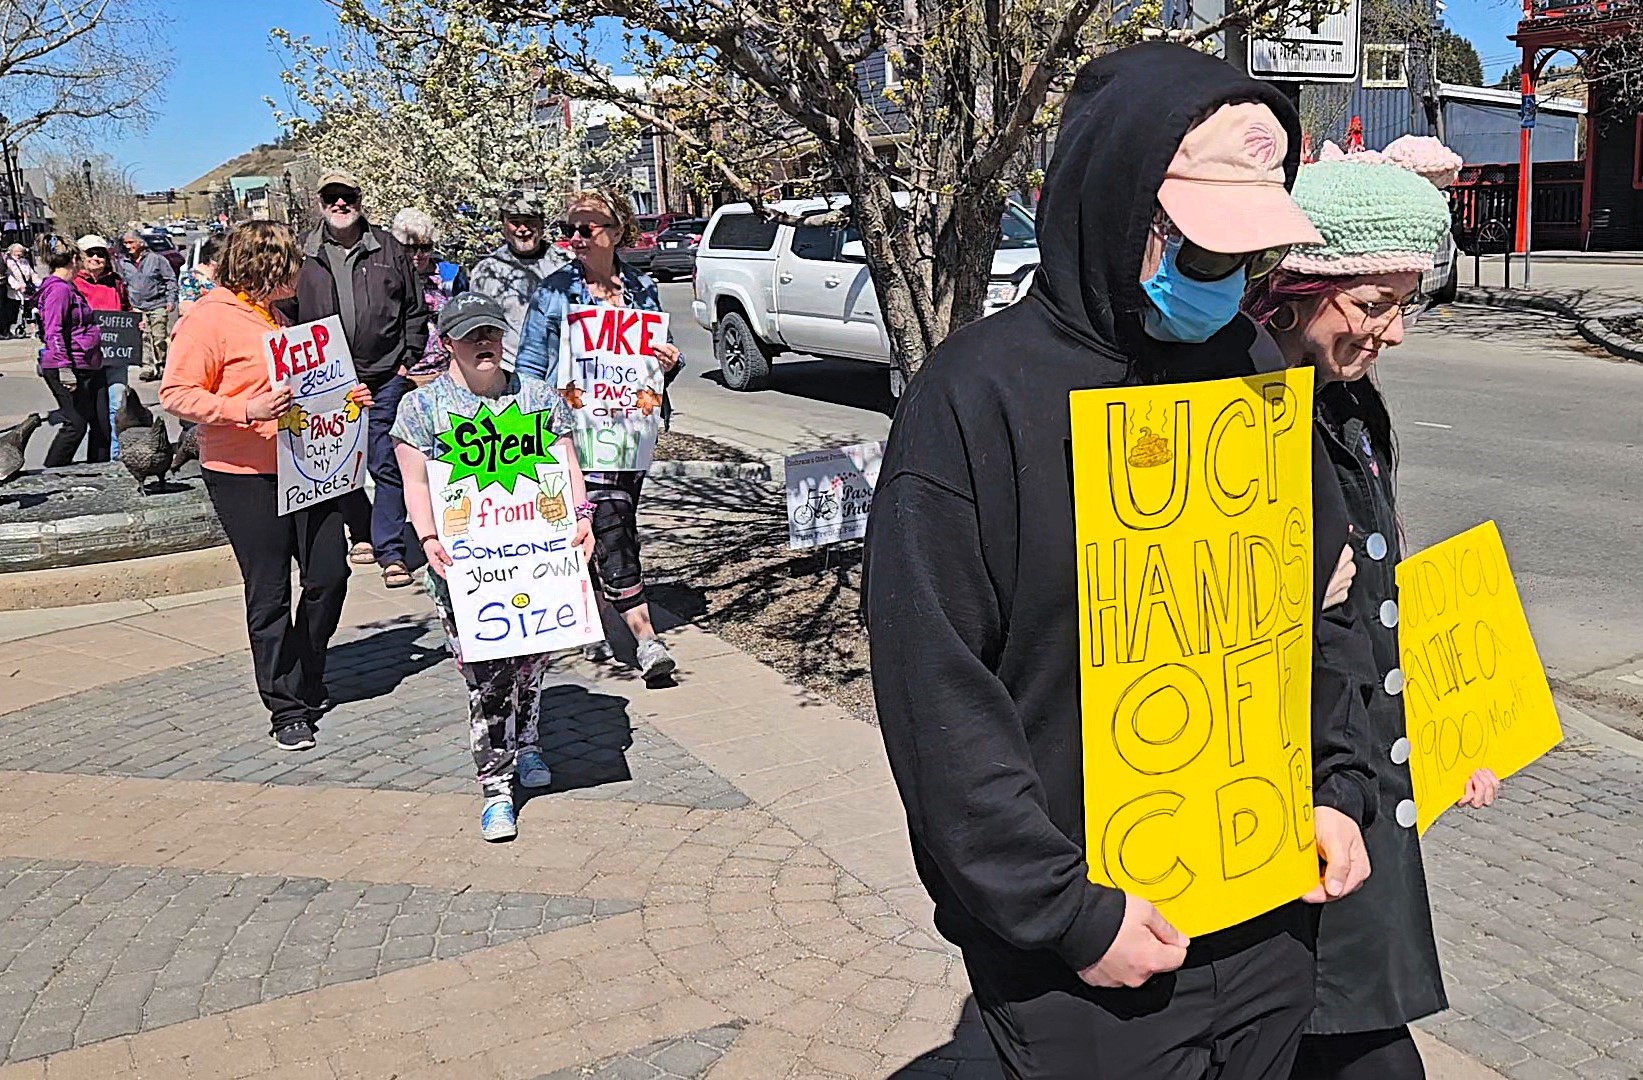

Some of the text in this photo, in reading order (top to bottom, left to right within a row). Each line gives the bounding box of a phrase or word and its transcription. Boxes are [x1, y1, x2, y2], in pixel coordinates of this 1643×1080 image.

[1331, 49, 1343, 62] 5m
[99, 315, 133, 328] SUFFER
[567, 309, 662, 357] TAKE
[116, 347, 133, 358] CUT
[269, 325, 329, 382] KEEP
[300, 360, 344, 395] your
[576, 356, 638, 384] Those
[594, 383, 632, 407] PAWS
[310, 413, 345, 440] PAWS
[593, 408, 637, 419] OFF
[306, 437, 343, 458] Out of
[454, 413, 546, 472] Steal
[1106, 382, 1297, 530] UCP
[314, 456, 331, 473] MY
[841, 484, 873, 502] Pasc
[477, 498, 535, 527] from
[842, 501, 870, 518] Pati
[452, 538, 567, 560] SOMEONE
[466, 551, 580, 595] your OWN
[1085, 507, 1307, 667] HANDS
[1399, 544, 1500, 639] ULD YOU
[1111, 623, 1304, 775] OFF
